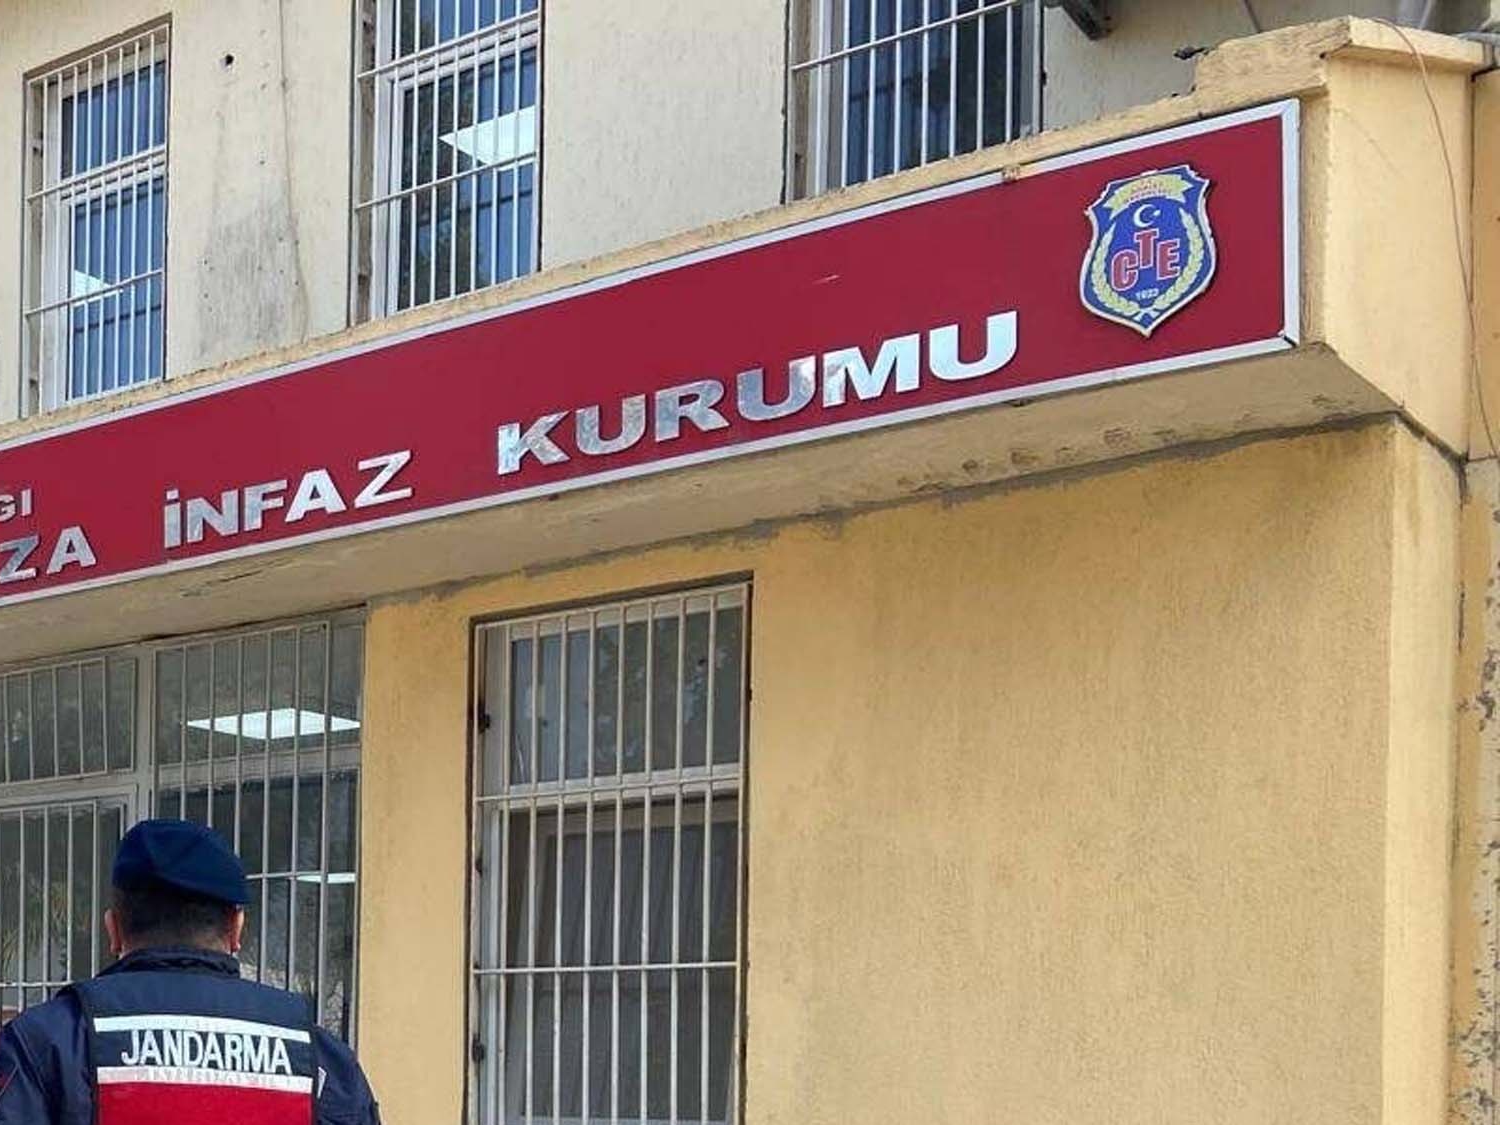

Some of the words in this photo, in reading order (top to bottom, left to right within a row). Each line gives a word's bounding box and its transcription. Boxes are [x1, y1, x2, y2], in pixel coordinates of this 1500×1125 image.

[1111, 228, 1181, 292] CTE
[163, 449, 414, 550] İNFAZ
[497, 310, 1020, 476] KURUMU
[121, 1029, 293, 1075] JANDARMA
